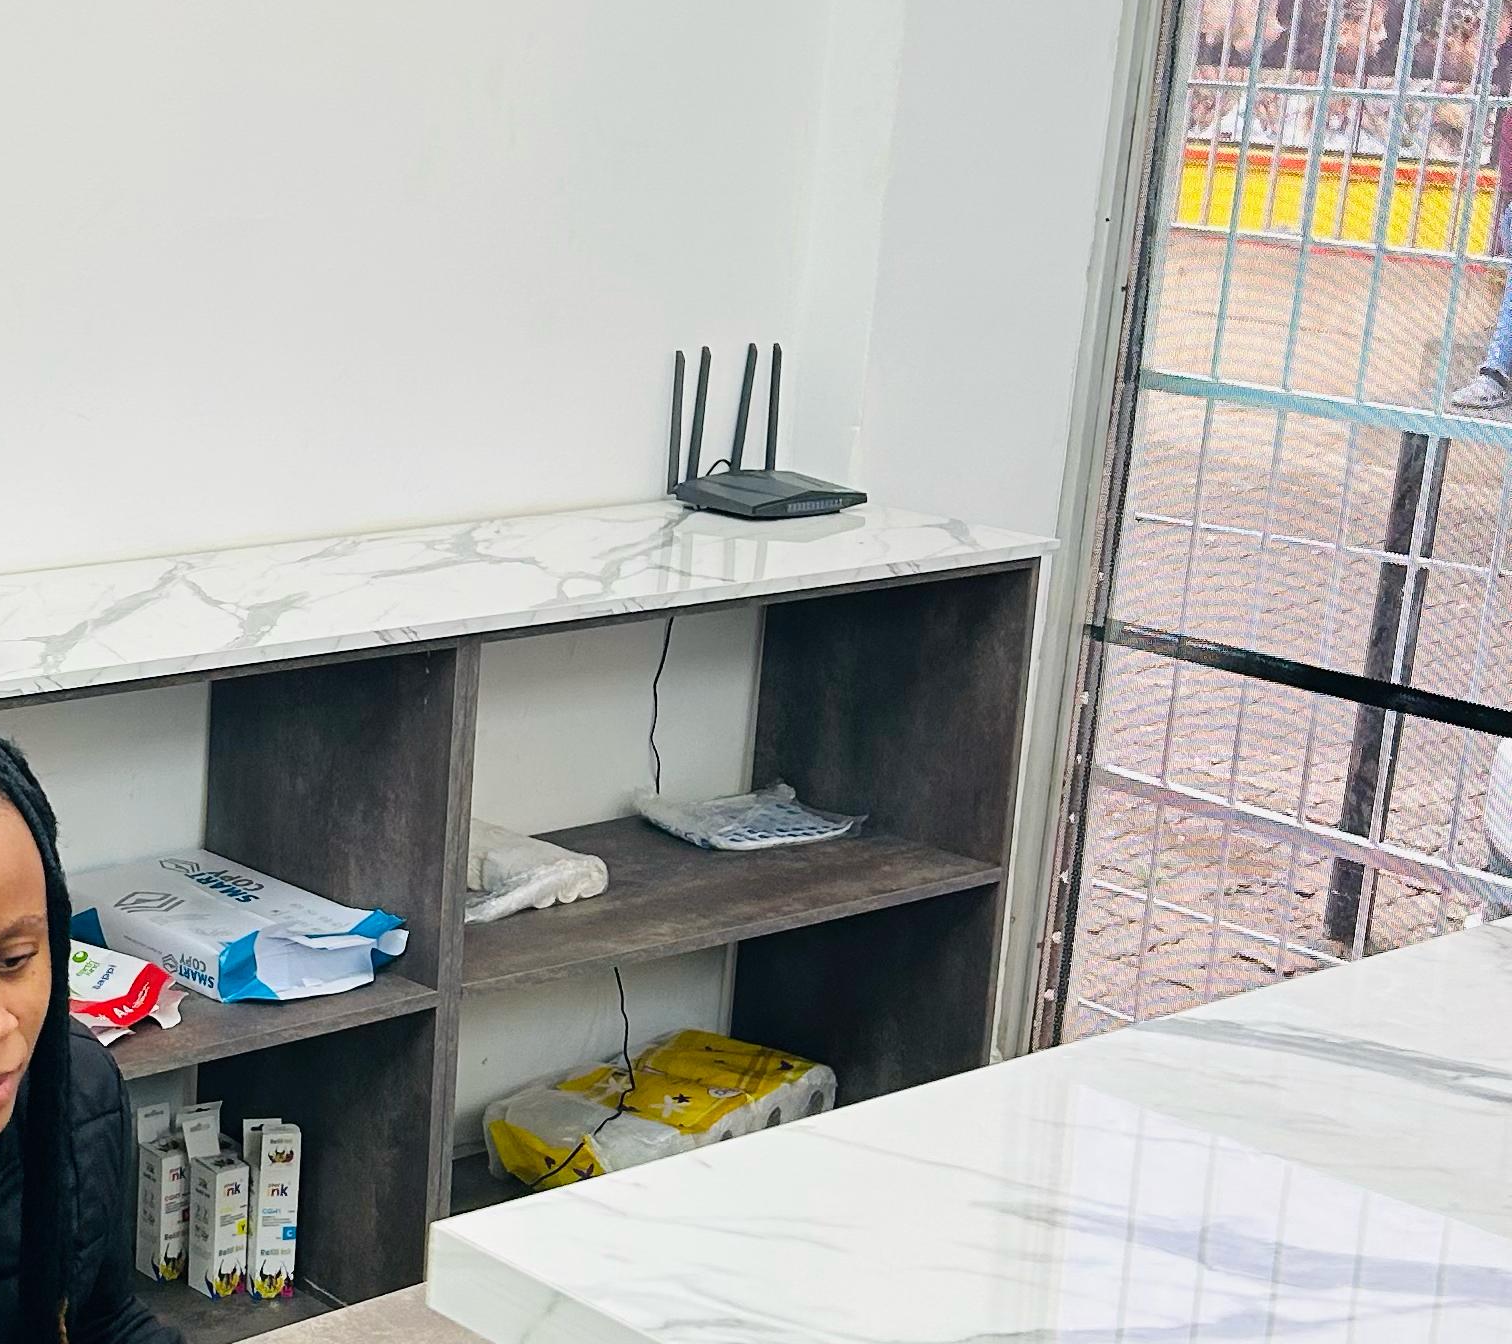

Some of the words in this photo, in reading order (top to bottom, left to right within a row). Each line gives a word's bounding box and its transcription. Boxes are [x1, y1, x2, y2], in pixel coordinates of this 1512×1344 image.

[185, 872, 259, 902] SMART
[205, 870, 264, 891] COPY
[180, 954, 206, 972] COPY
[179, 966, 214, 988] SMART
